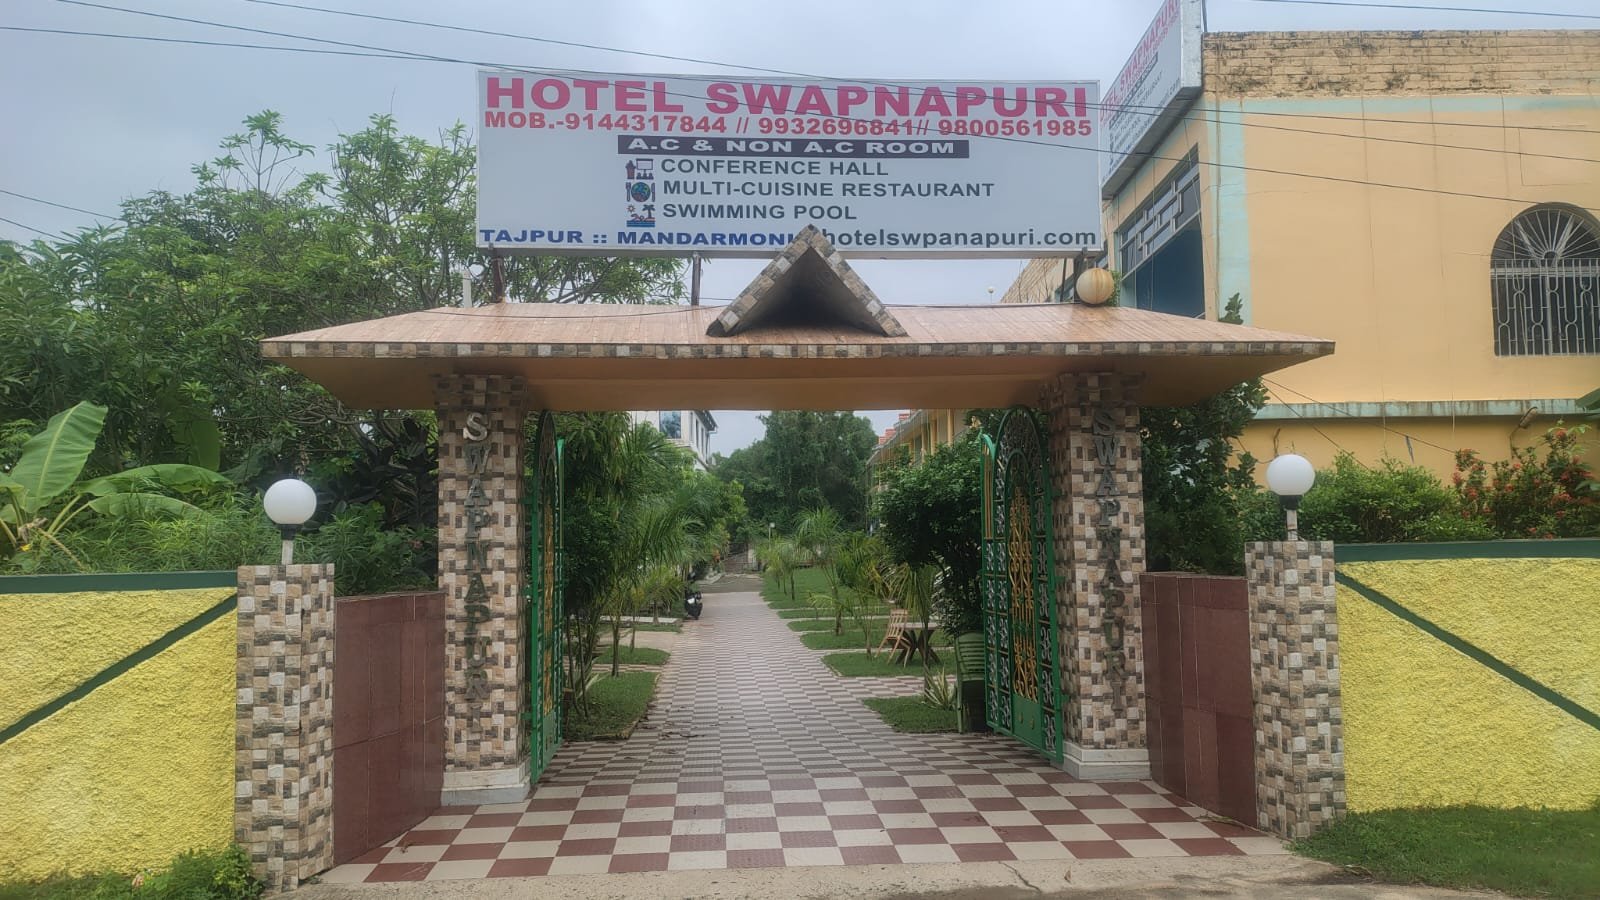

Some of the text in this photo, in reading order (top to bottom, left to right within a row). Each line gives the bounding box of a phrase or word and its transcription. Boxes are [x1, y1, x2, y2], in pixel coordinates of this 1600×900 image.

[486, 77, 684, 113] HOTEL
[705, 82, 1087, 118] SWAPNAPURI
[938, 119, 1092, 136] 9800561985
[628, 138, 955, 154] A.C & NON A.C ROOM
[661, 158, 889, 176] CONFERENCE HALL
[663, 180, 995, 198] MULTI-CUISINE RESTAURANT
[662, 203, 857, 220] SWIMMING POOL
[479, 229, 584, 244] TAJPUR
[1092, 407, 1128, 713] SWAPNAPURI
[462, 411, 492, 734] SWAPNAPURI
